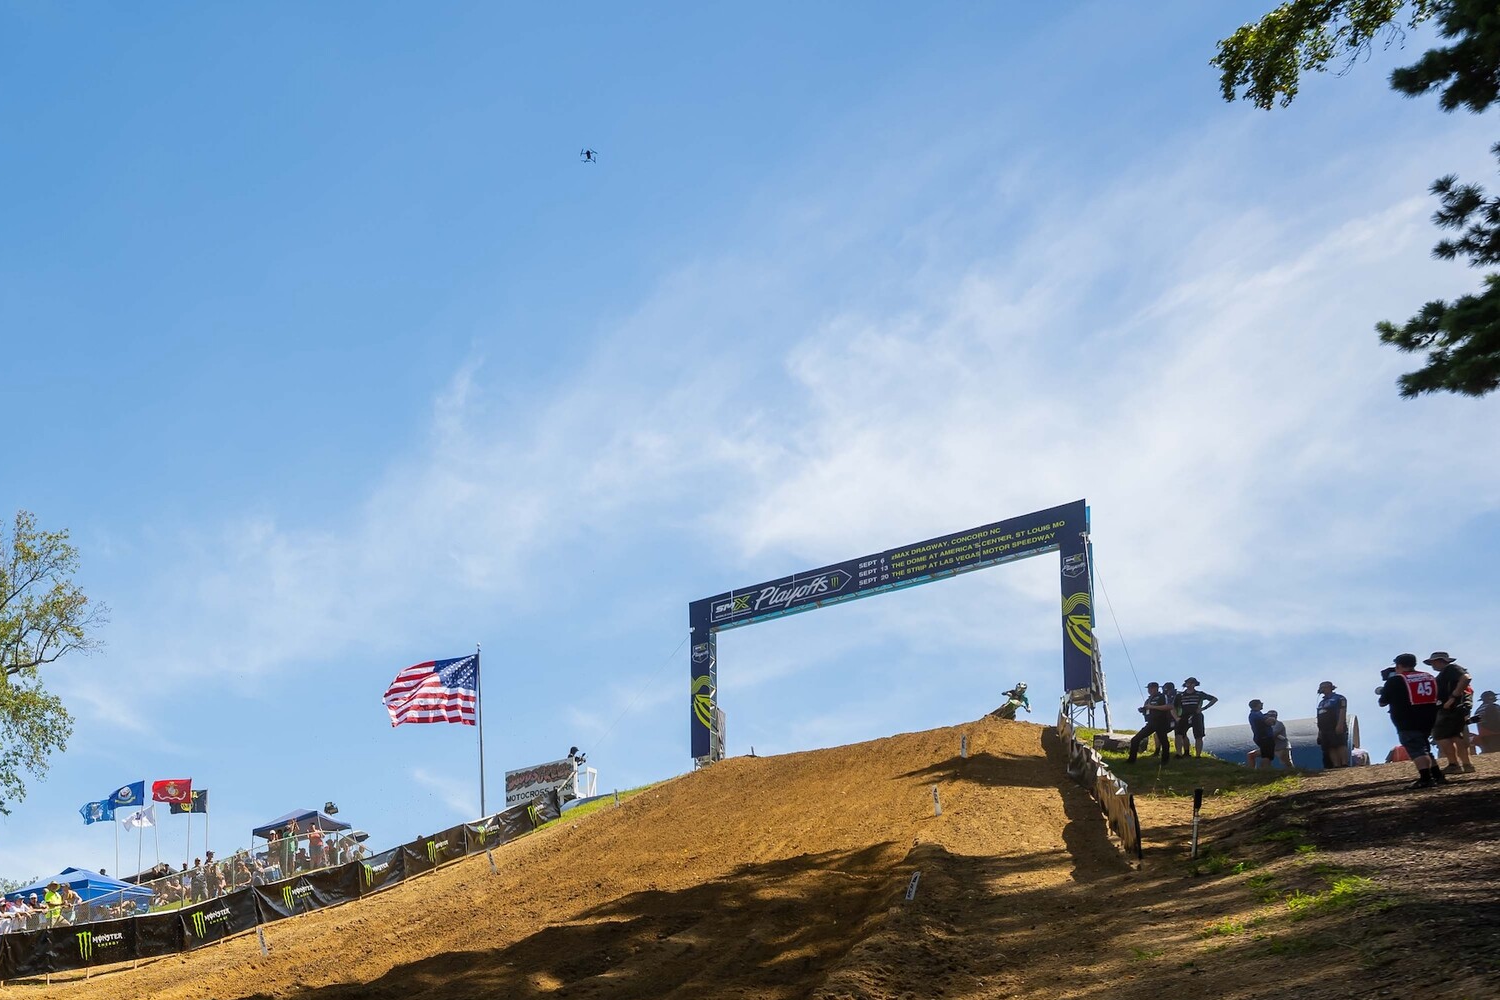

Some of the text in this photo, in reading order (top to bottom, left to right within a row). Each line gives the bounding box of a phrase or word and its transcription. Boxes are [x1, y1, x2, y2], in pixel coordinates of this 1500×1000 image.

[859, 560, 878, 569] SEPT
[911, 541, 950, 555] DRAGWAY,
[951, 529, 988, 545] CONCORD
[990, 527, 1000, 535] NC
[859, 568, 878, 577] SEPT
[880, 564, 888, 572] 13
[891, 561, 904, 569] THE
[906, 556, 927, 566] DOME
[940, 542, 980, 557] AMERICA'S
[1016, 530, 1025, 538] ST
[1027, 524, 1050, 534] LOUIS
[1052, 520, 1066, 528] MO
[859, 576, 878, 586] SEPT
[892, 570, 905, 578] THE
[906, 564, 927, 574] STRIP
[940, 558, 954, 566] LAS
[956, 552, 980, 562] VEGAS
[982, 542, 1010, 556] MOTOR
[1012, 532, 1056, 548] SPEEDWAY
[716, 596, 750, 613] SMX
[754, 576, 828, 610] Playoffs
[1417, 682, 1432, 696] 45
[506, 786, 549, 802] MOTOCROSS
[204, 908, 230, 921] MONSTER
[92, 932, 122, 943] MONSTER
